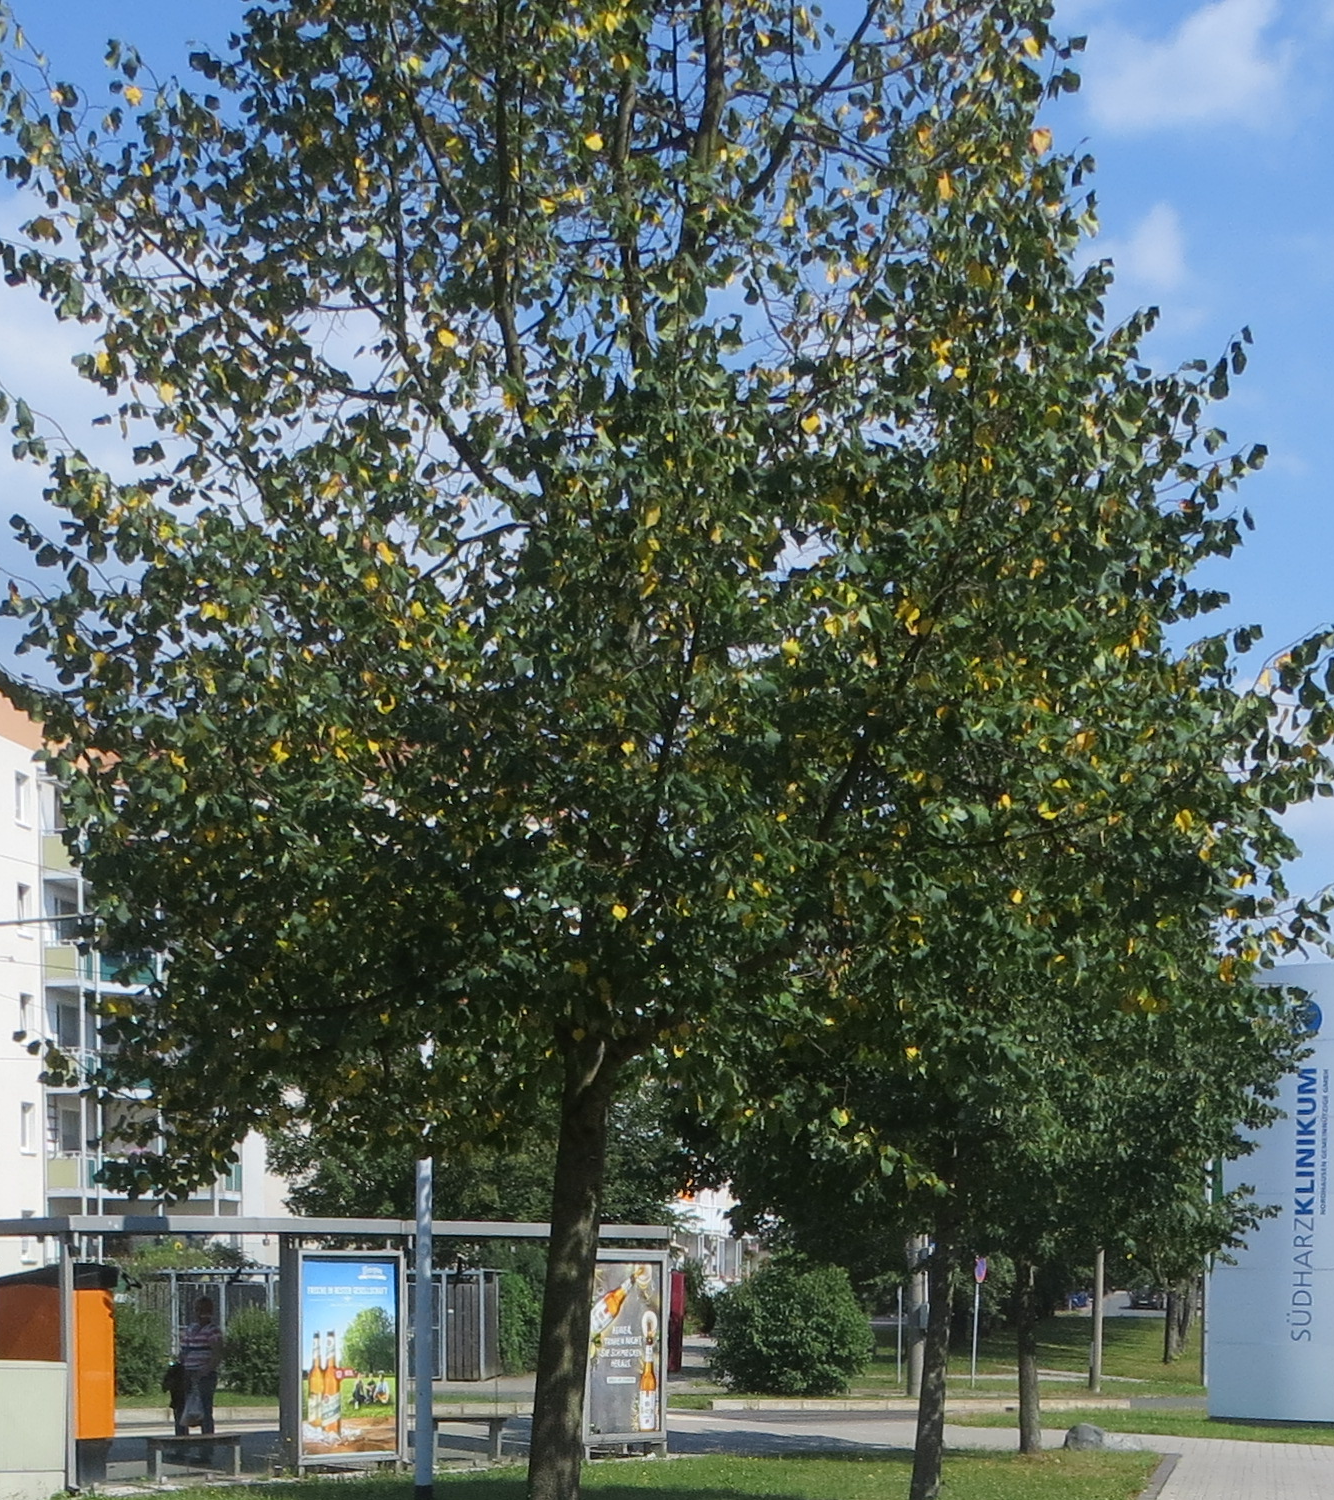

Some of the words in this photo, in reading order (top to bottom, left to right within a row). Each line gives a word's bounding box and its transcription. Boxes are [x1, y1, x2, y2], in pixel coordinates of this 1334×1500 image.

[1321, 1095, 1329, 1160] GEMEINNÜTZIGE
[1286, 1068, 1317, 1341] SÜDHARZKLINIKUM
[1320, 1161, 1328, 1216] NORDHAUSEN
